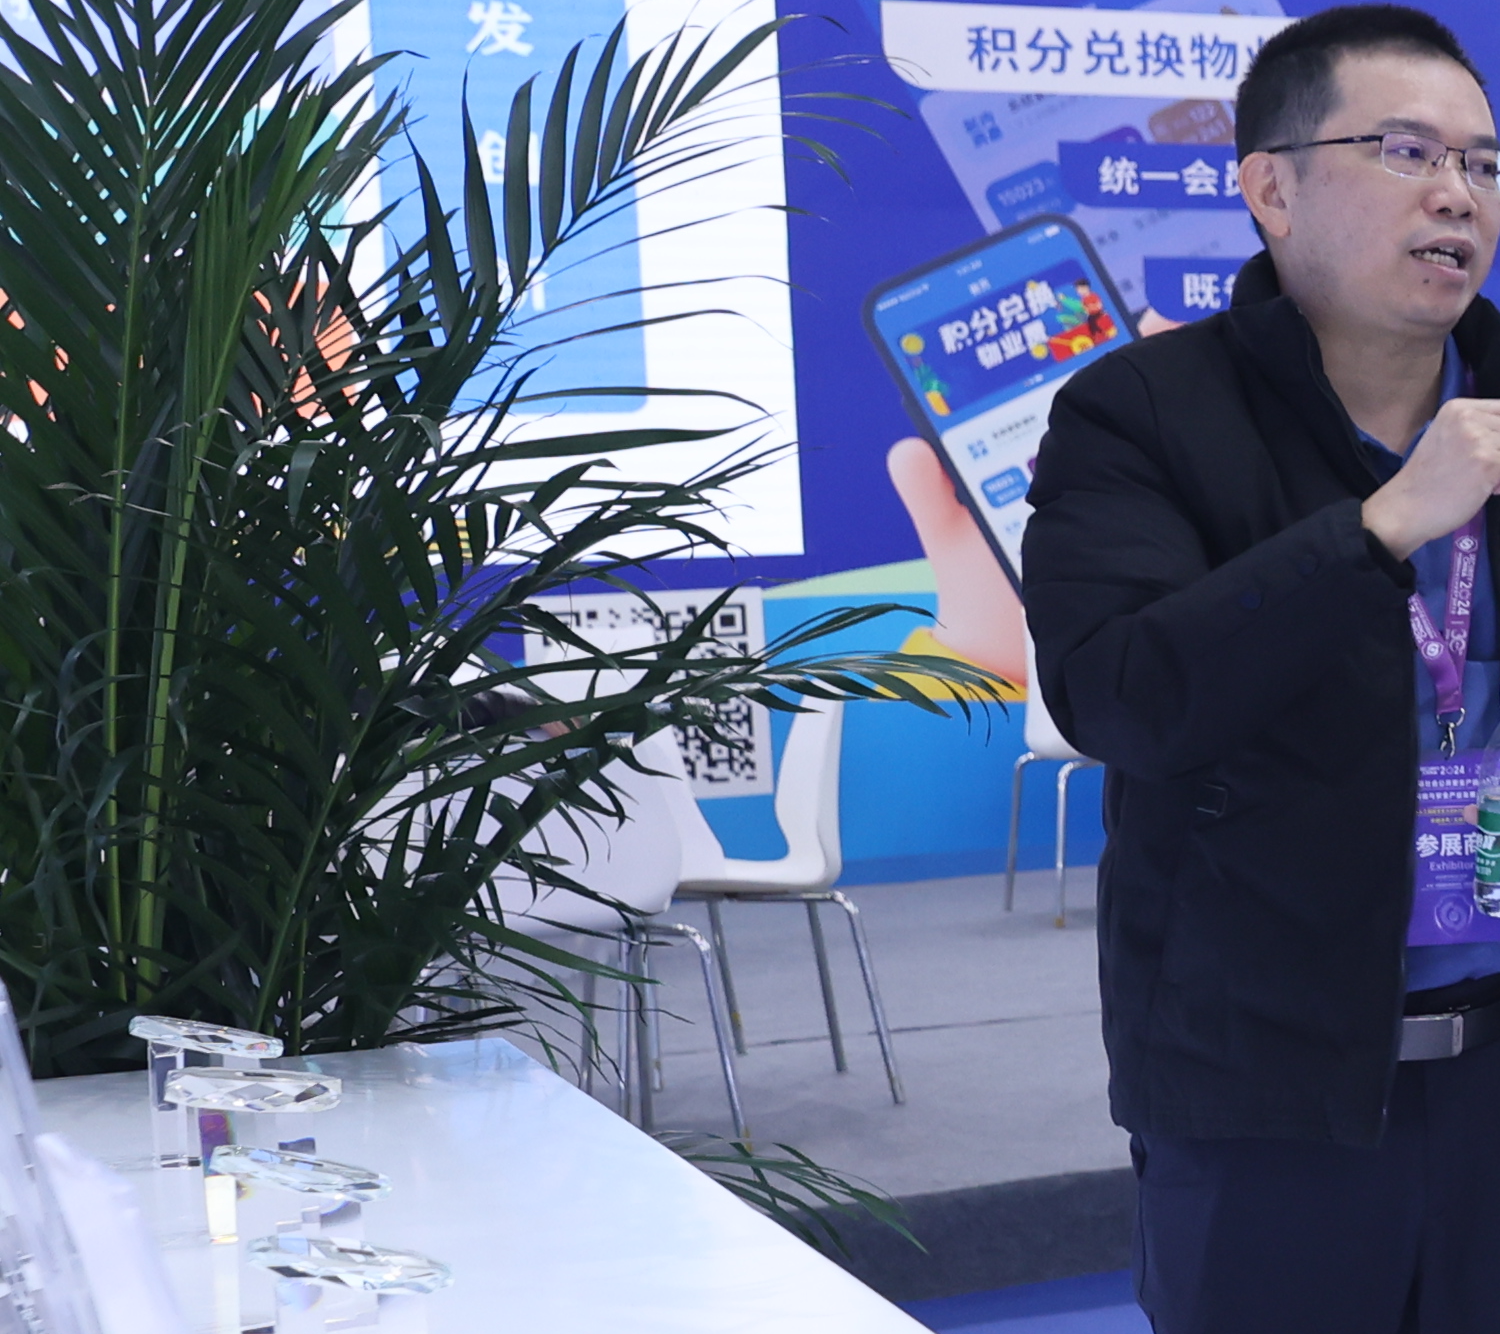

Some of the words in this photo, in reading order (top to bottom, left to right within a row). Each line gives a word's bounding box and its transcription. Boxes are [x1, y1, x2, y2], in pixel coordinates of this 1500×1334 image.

[967, 25, 1258, 79] 积分兑换物
[938, 279, 1060, 356] 积分兑换
[1457, 582, 1474, 616] 2024
